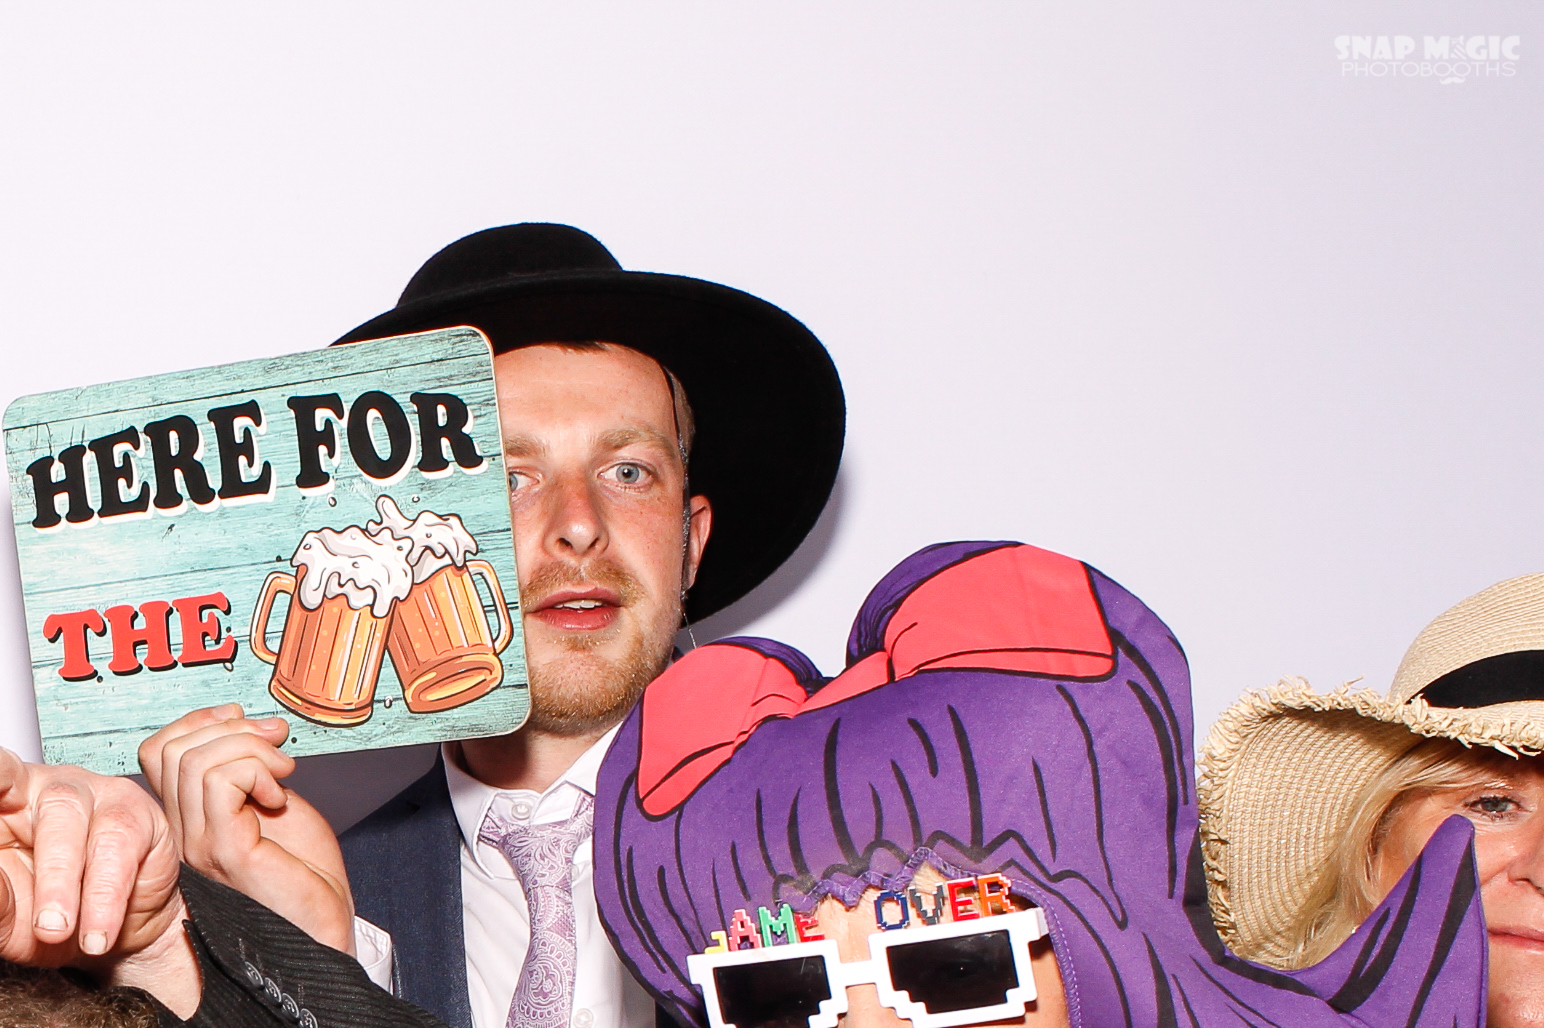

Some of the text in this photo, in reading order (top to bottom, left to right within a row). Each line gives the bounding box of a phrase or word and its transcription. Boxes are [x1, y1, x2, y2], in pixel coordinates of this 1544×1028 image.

[26, 390, 490, 530] HERE FOR
[43, 591, 238, 683] THE
[874, 873, 1016, 931] OVER
